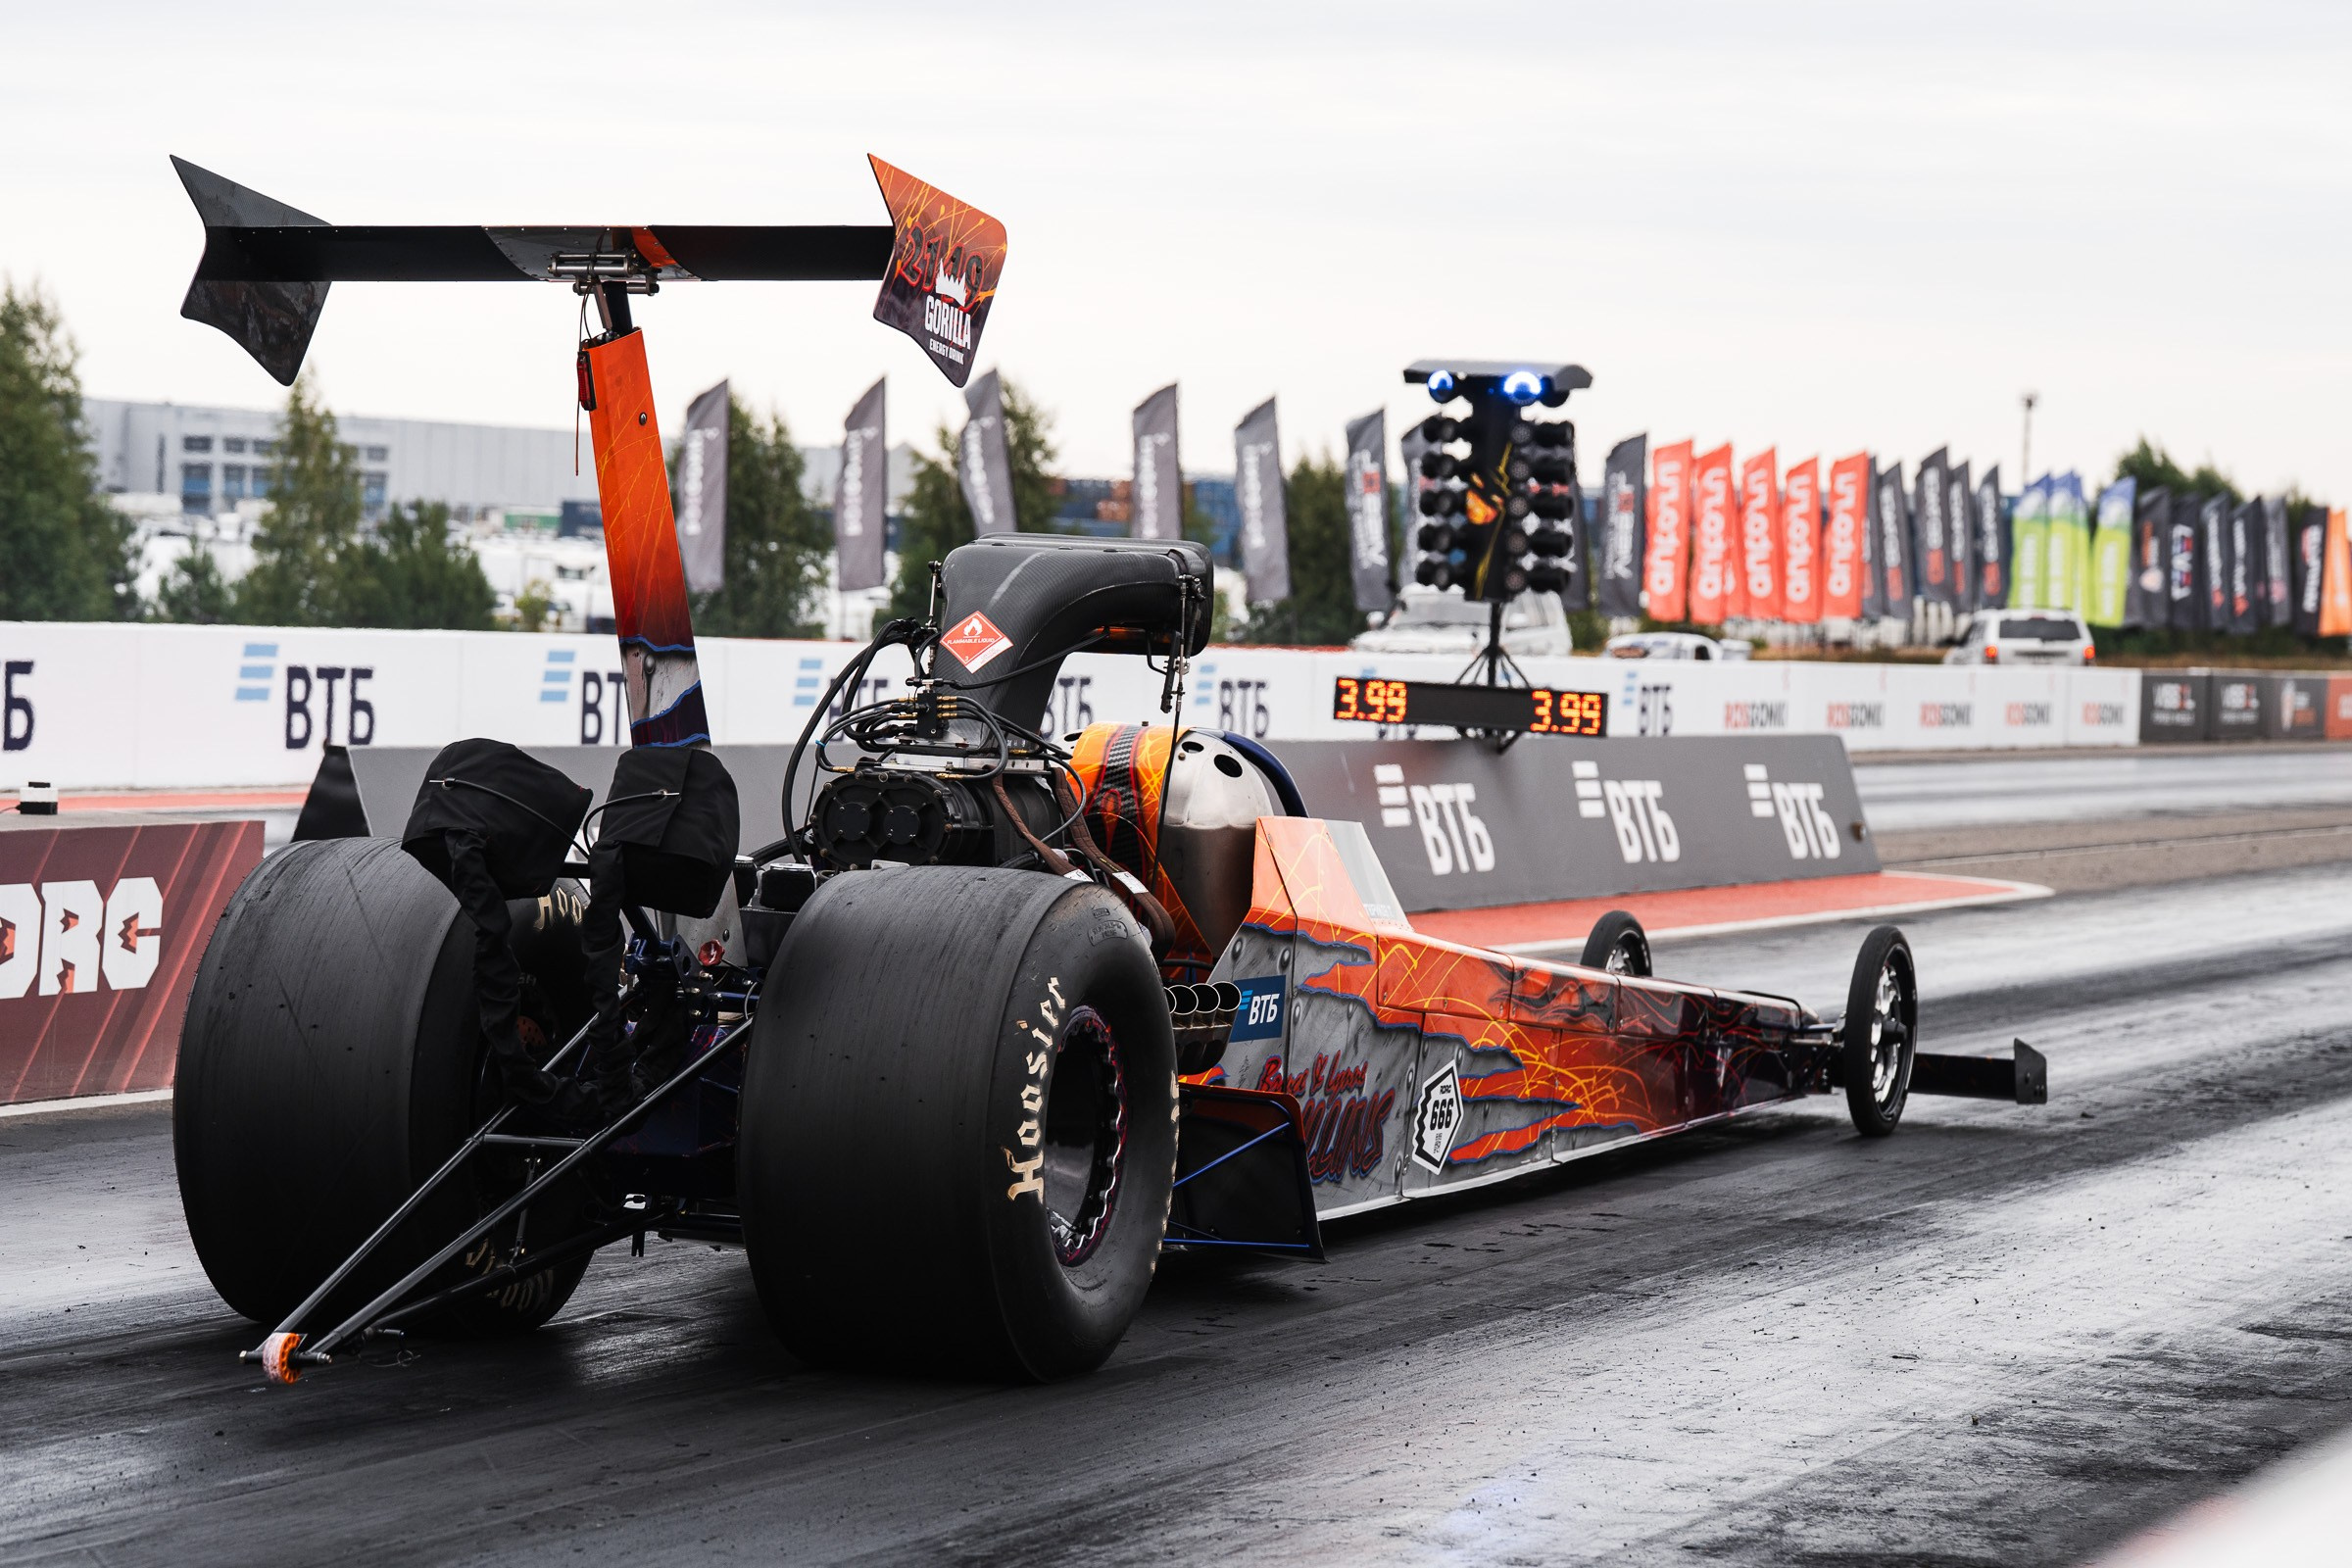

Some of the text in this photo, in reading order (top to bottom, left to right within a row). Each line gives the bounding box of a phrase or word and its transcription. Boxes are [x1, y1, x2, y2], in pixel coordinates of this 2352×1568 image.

[925, 295, 971, 350] GORILLA
[930, 338, 964, 366] ENERGY DRINK
[286, 665, 374, 749] ВТБ
[581, 671, 626, 745] ВТ
[1336, 679, 1407, 723] 3.99
[1530, 689, 1601, 735] 3.99
[1410, 783, 1495, 875] ВТБ
[1604, 781, 1681, 862] ВТБ
[1772, 783, 1840, 859] ВТБ
[1249, 993, 1280, 1026] ВТБ
[1001, 976, 1066, 1205] Hoosier
[1430, 1098, 1454, 1130] 666
